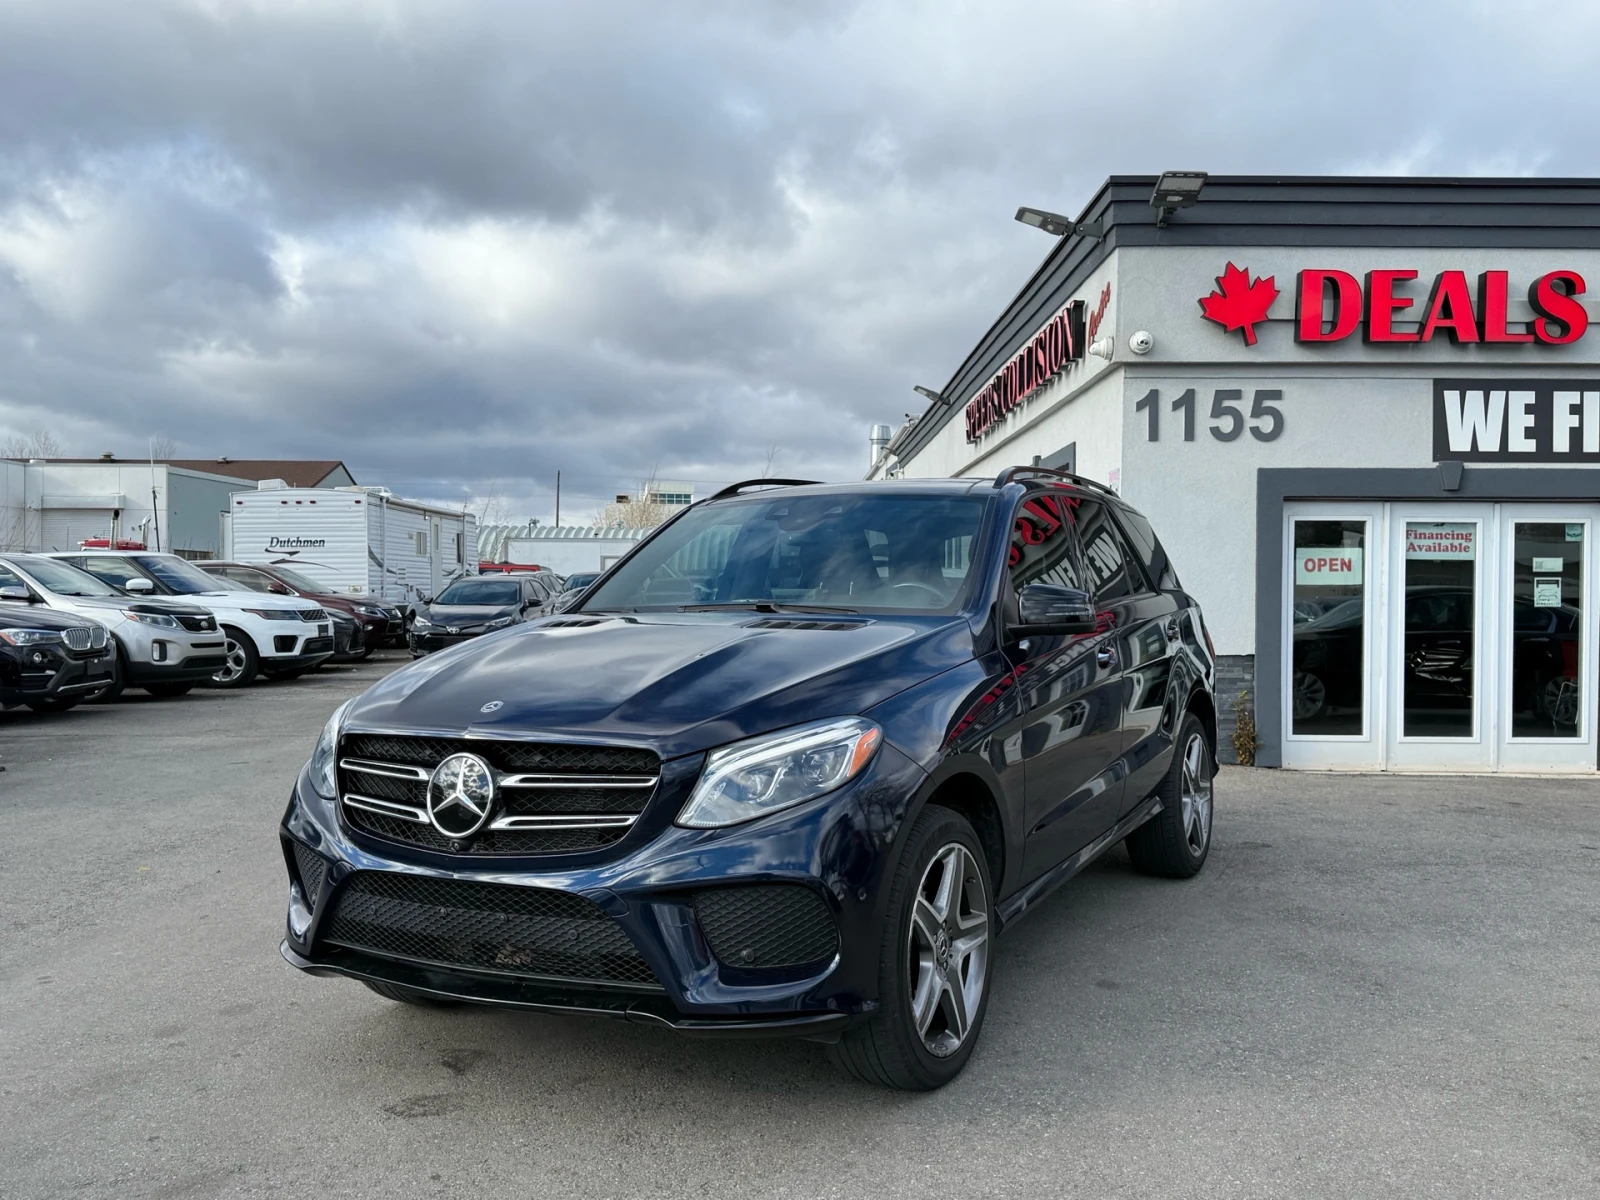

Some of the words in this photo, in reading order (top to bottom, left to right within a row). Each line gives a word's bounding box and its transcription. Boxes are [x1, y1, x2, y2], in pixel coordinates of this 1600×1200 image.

[1295, 269, 1588, 344] DEALS
[1001, 300, 1086, 414] COLLISION
[1136, 388, 1285, 443] 1155
[1444, 390, 1537, 453] WE
[269, 536, 325, 548] Dutchmen
[1406, 530, 1472, 542] Financing
[1407, 542, 1470, 552] Available
[1304, 558, 1352, 573] OPEN
